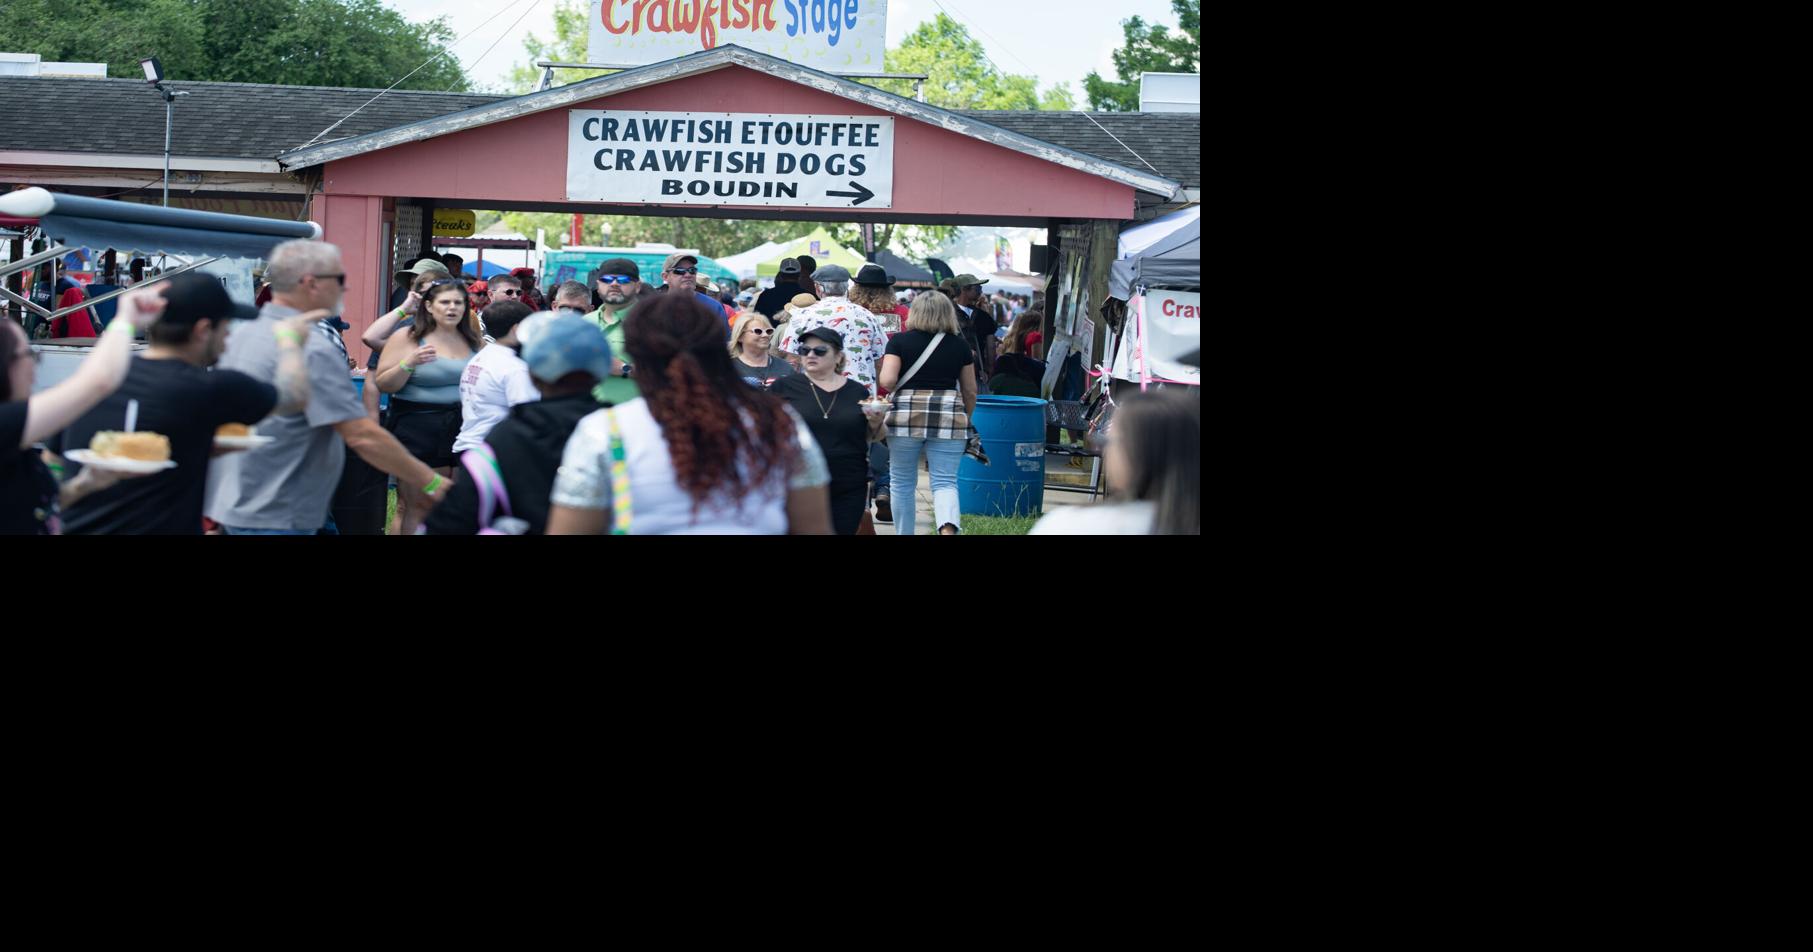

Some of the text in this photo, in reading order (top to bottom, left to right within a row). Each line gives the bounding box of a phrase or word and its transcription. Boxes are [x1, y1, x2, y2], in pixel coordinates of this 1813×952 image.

[601, 0, 858, 50] Crawfish Stage
[582, 117, 880, 147] CRAWFISH ETOUFFEE
[593, 149, 867, 177] CRAWFISH DOGS
[661, 180, 798, 199] BOUDIN
